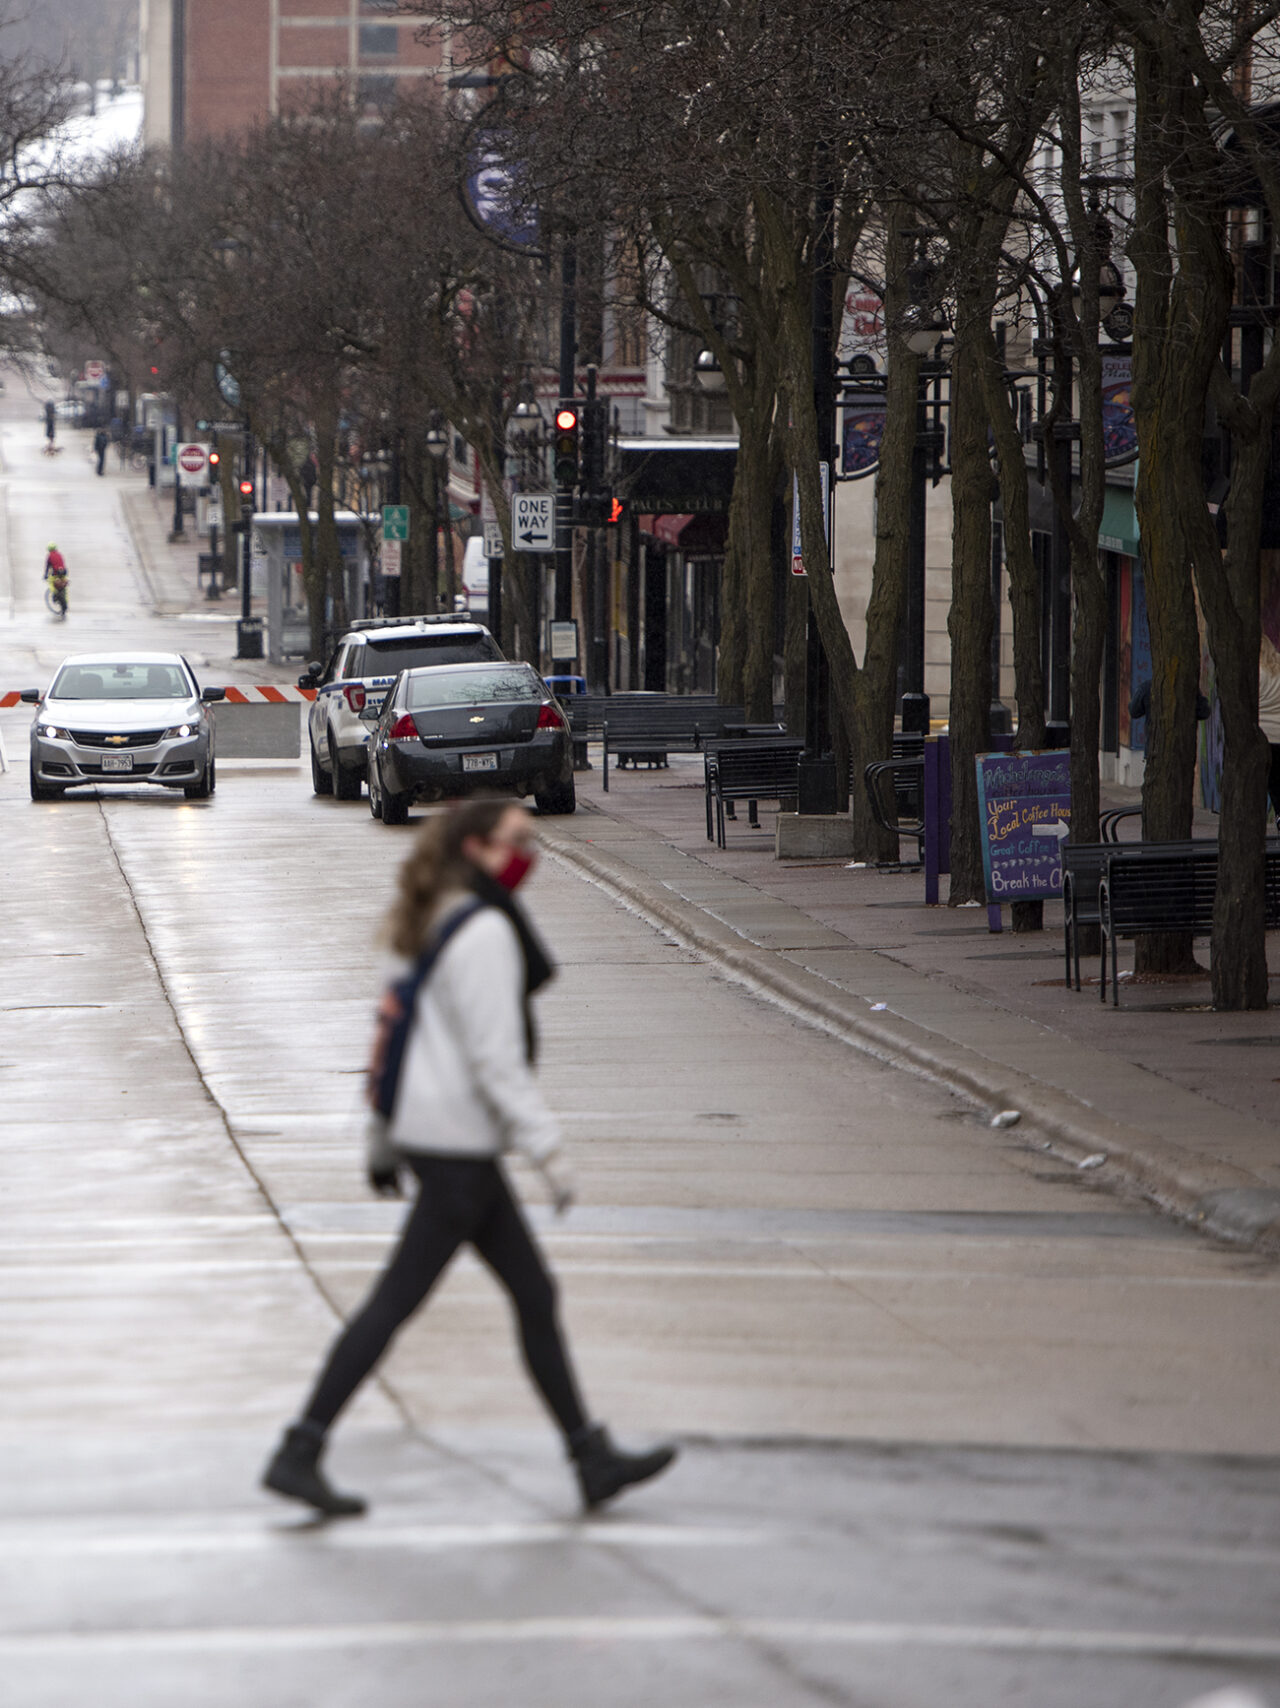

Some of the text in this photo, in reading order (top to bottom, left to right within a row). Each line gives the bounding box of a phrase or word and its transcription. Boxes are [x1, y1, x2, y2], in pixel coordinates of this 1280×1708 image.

[519, 500, 548, 513] ONE
[518, 515, 548, 528] WAY
[487, 540, 504, 554] 15
[987, 800, 1017, 820] Your
[988, 812, 1021, 840] Local
[1022, 804, 1048, 823] Coffee
[991, 843, 1015, 856] Great
[992, 870, 1030, 892] Break
[1032, 876, 1048, 888] the
